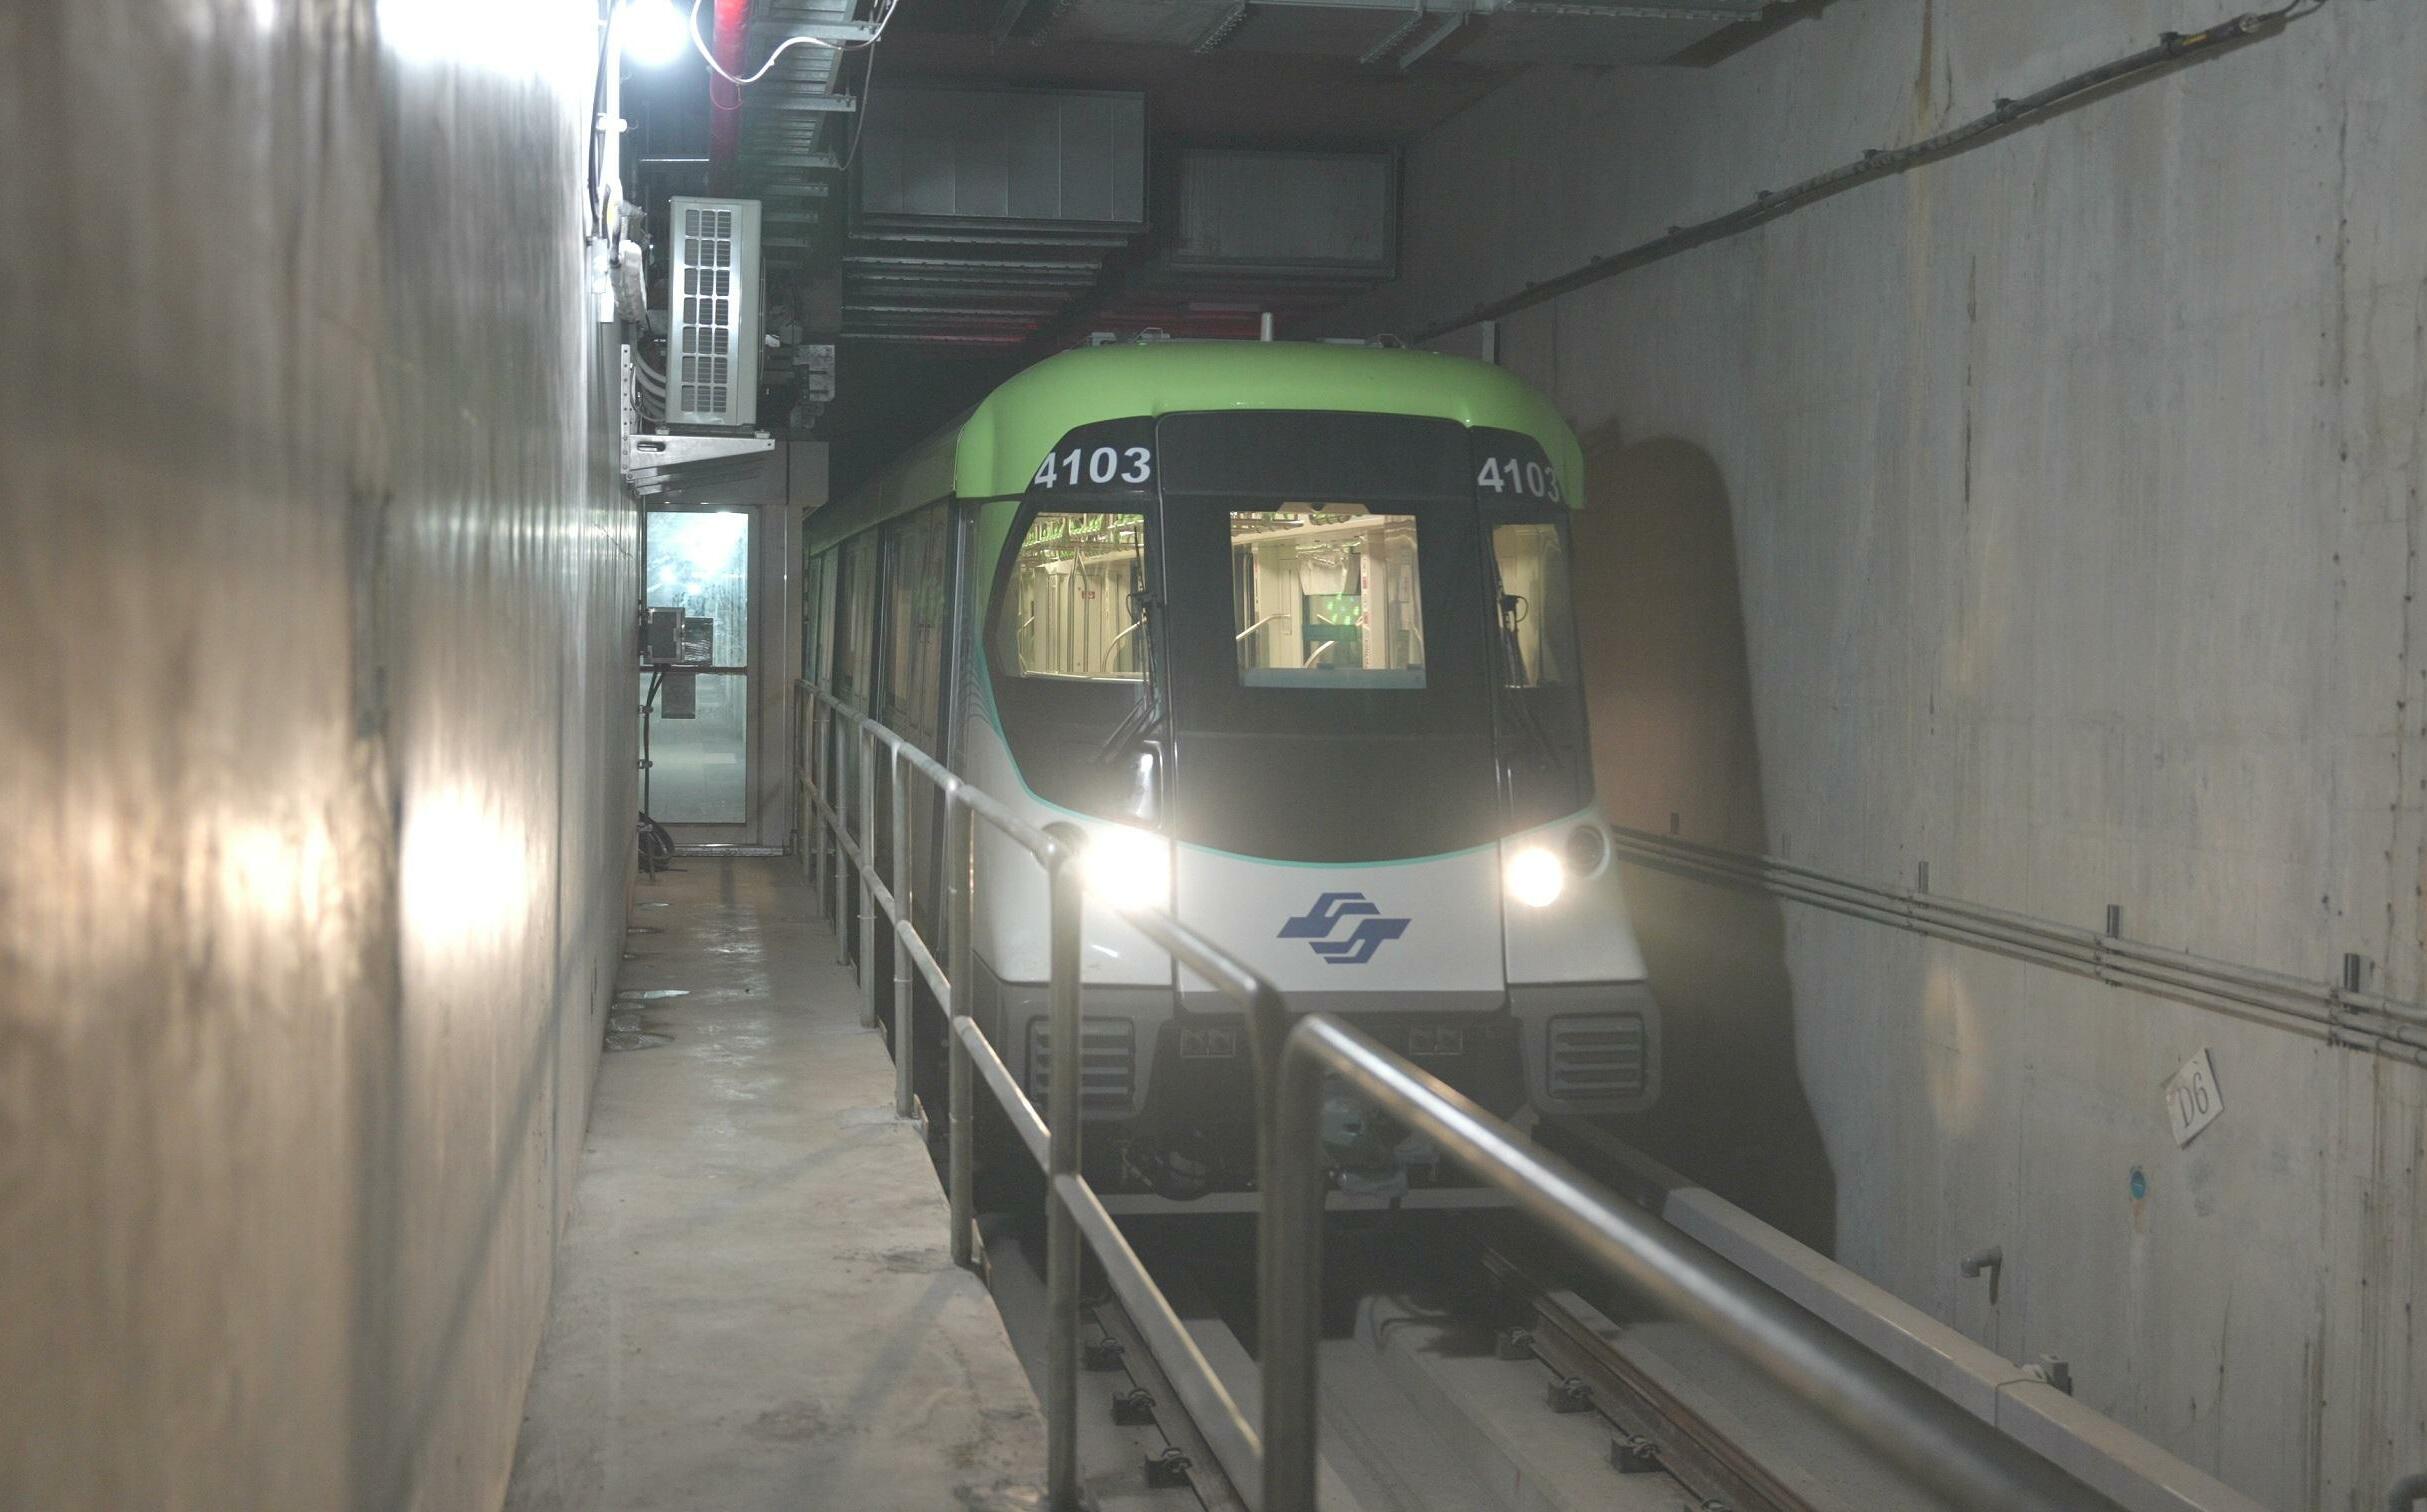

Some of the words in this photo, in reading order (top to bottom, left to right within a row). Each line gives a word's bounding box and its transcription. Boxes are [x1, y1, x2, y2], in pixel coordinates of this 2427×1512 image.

[1034, 447, 1151, 489] 4103
[1477, 457, 1560, 502] 4103
[2176, 1071, 2209, 1129] D6
